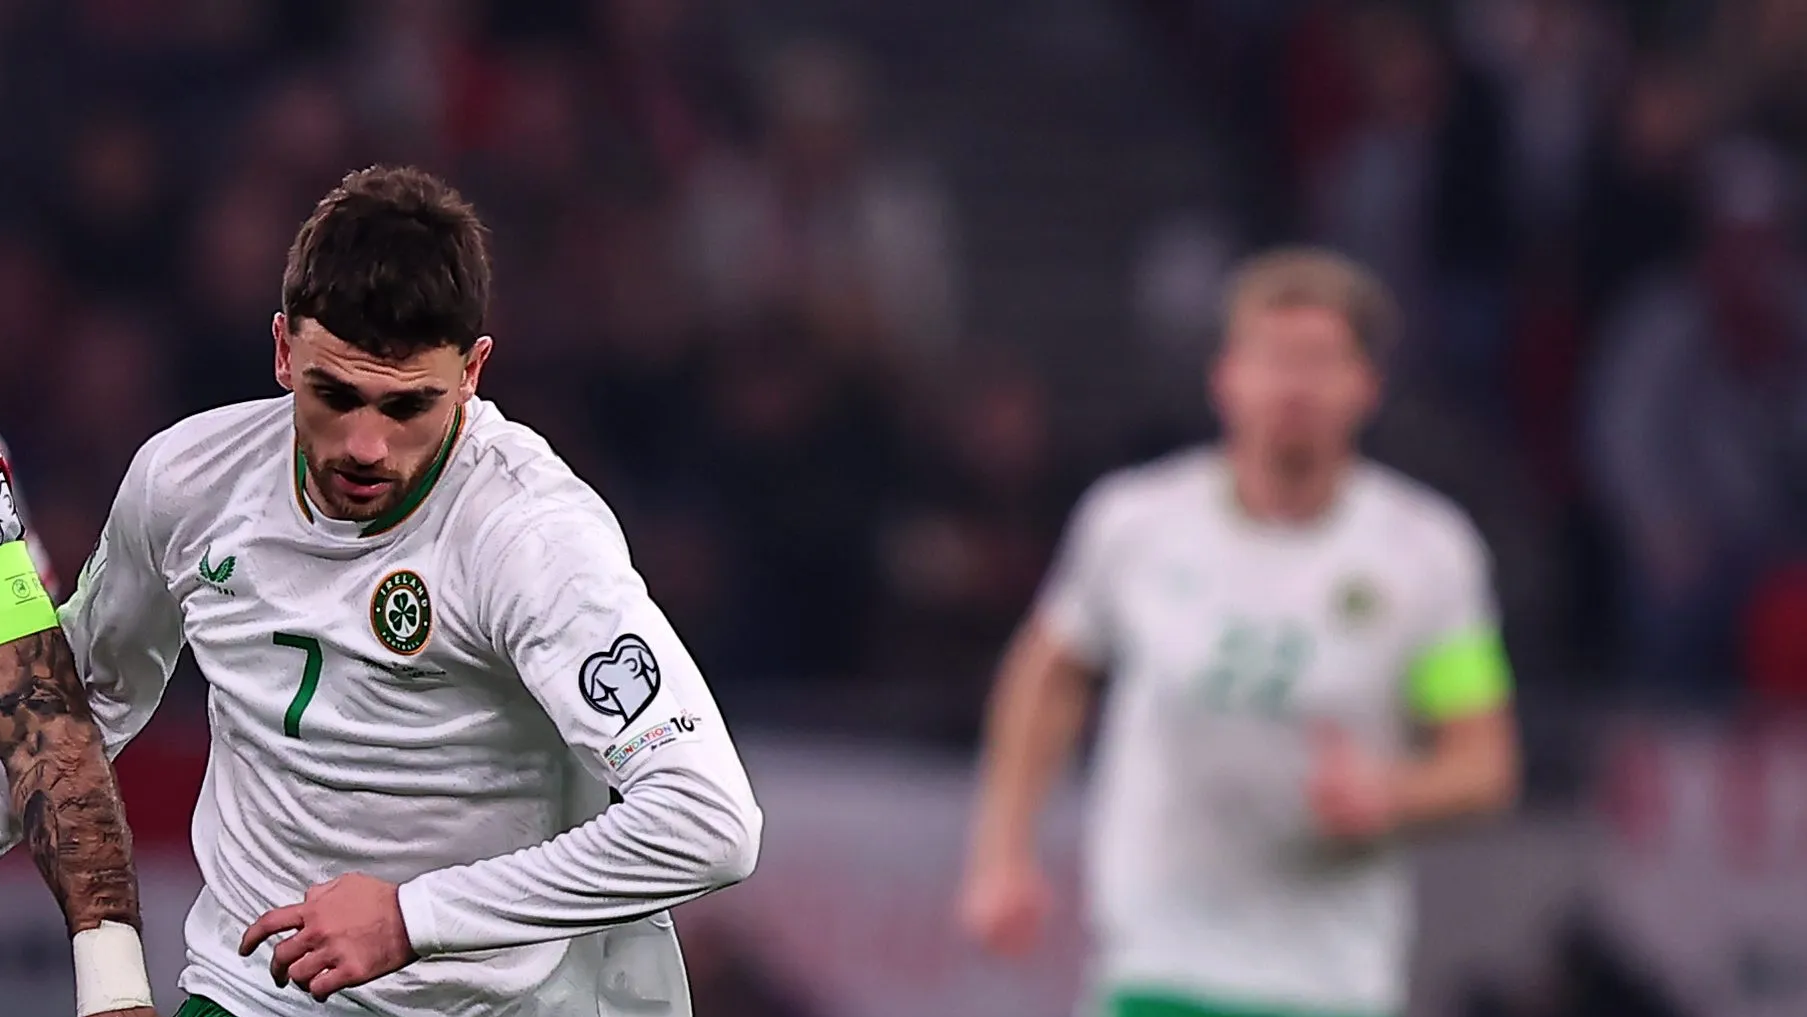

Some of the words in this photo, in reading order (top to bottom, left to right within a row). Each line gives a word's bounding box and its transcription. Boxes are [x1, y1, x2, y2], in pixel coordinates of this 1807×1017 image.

[380, 573, 429, 609] IRELAND
[271, 631, 324, 739] 7
[609, 724, 673, 769] FOUNDATION
